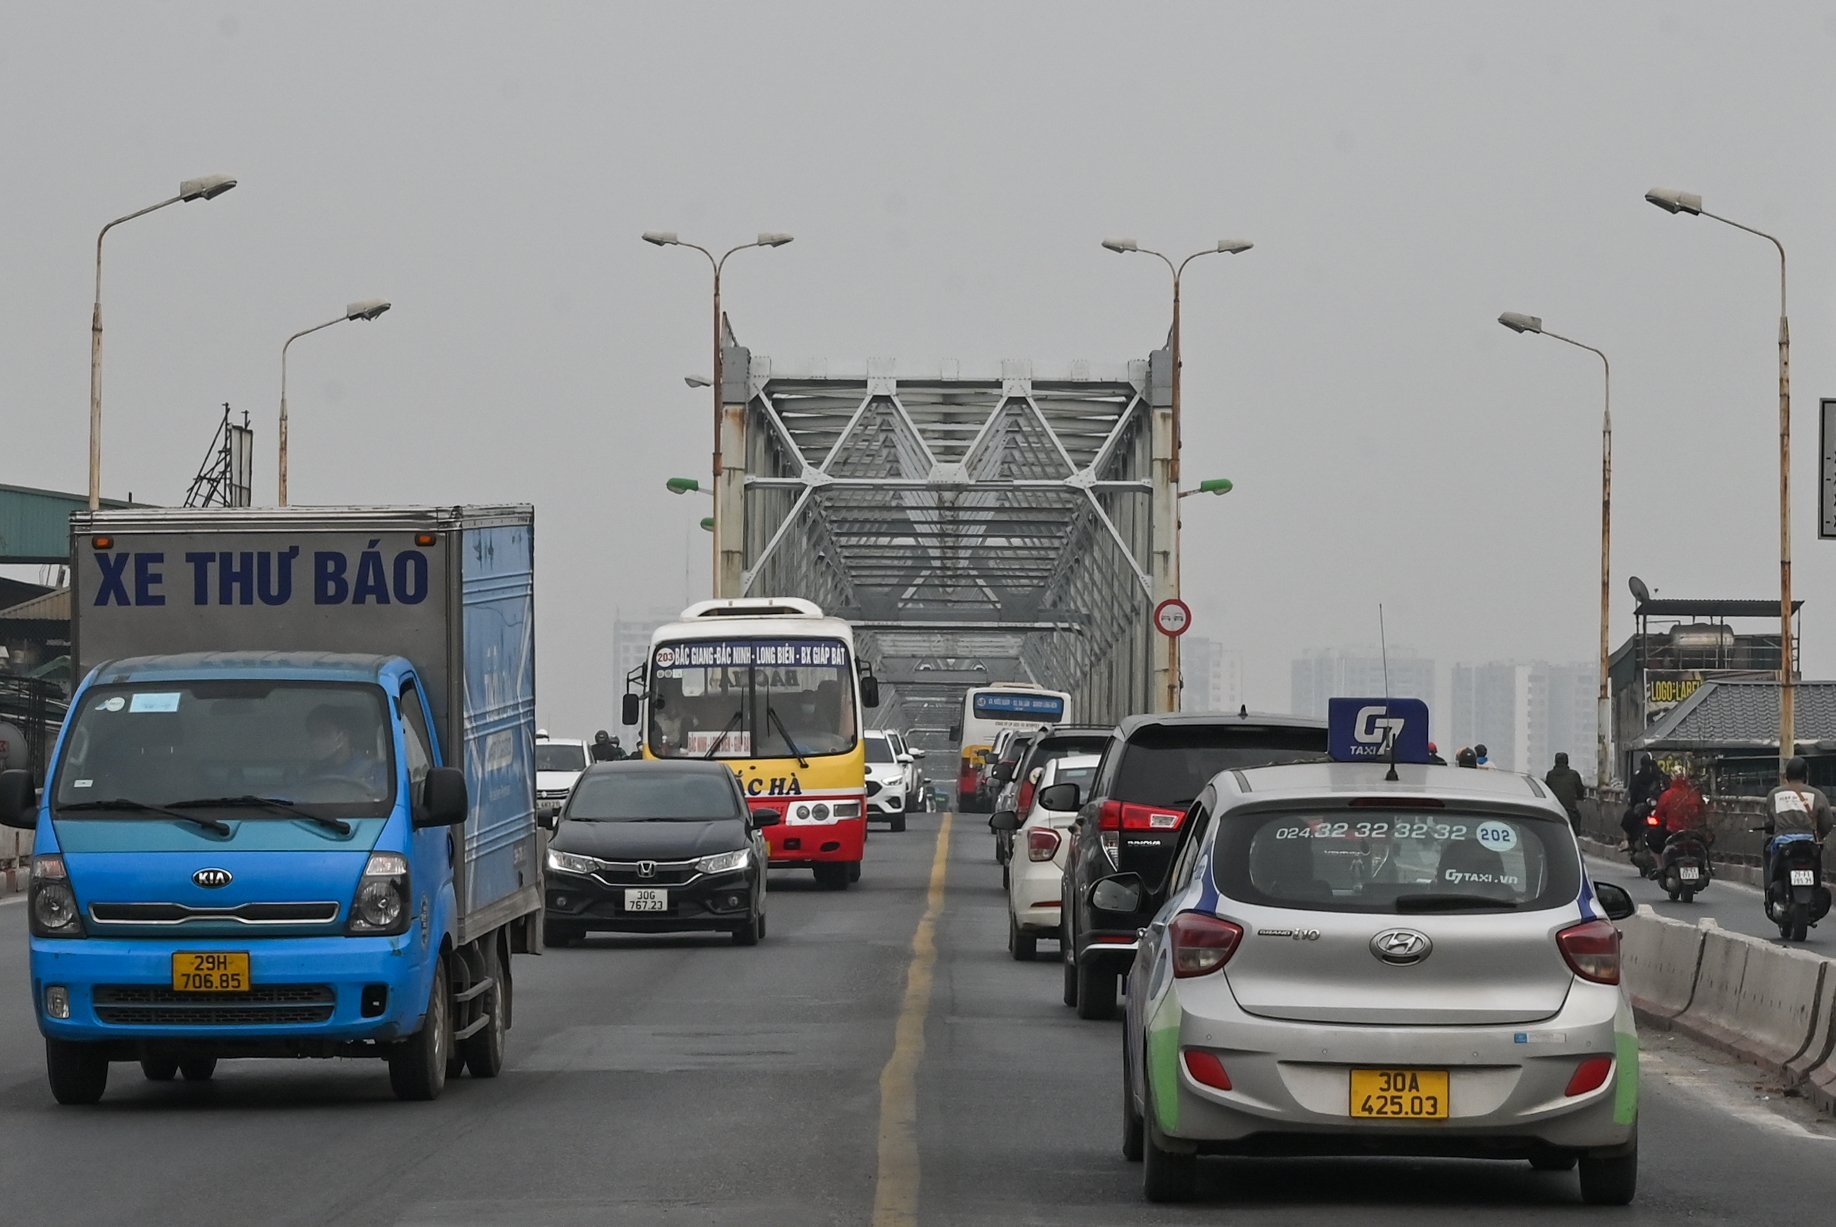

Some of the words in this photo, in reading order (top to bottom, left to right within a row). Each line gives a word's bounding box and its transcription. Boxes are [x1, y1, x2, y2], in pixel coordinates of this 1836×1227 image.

[93, 552, 166, 606] XE
[185, 545, 300, 606] THƯ
[313, 538, 429, 606] BÁO
[657, 653, 674, 663] 203
[733, 646, 751, 665] NINH
[756, 646, 776, 665] LONG
[777, 643, 795, 665] BIÊN
[801, 646, 812, 665] BX
[813, 643, 829, 665] GIÁP
[1353, 705, 1406, 756] G7
[1349, 745, 1377, 755] TAXI
[768, 772, 802, 796] HÀ
[1354, 822, 1389, 838] 32
[1394, 822, 1428, 839] 32
[1434, 824, 1468, 840] 32
[1481, 828, 1511, 842] 202
[198, 871, 226, 884] KIA
[637, 890, 656, 900] 30G
[629, 900, 663, 910] 767.23
[193, 955, 228, 971] 29H
[181, 973, 241, 990] 706.85
[1378, 1072, 1420, 1093] 30A
[1360, 1094, 1438, 1116] 425.03
